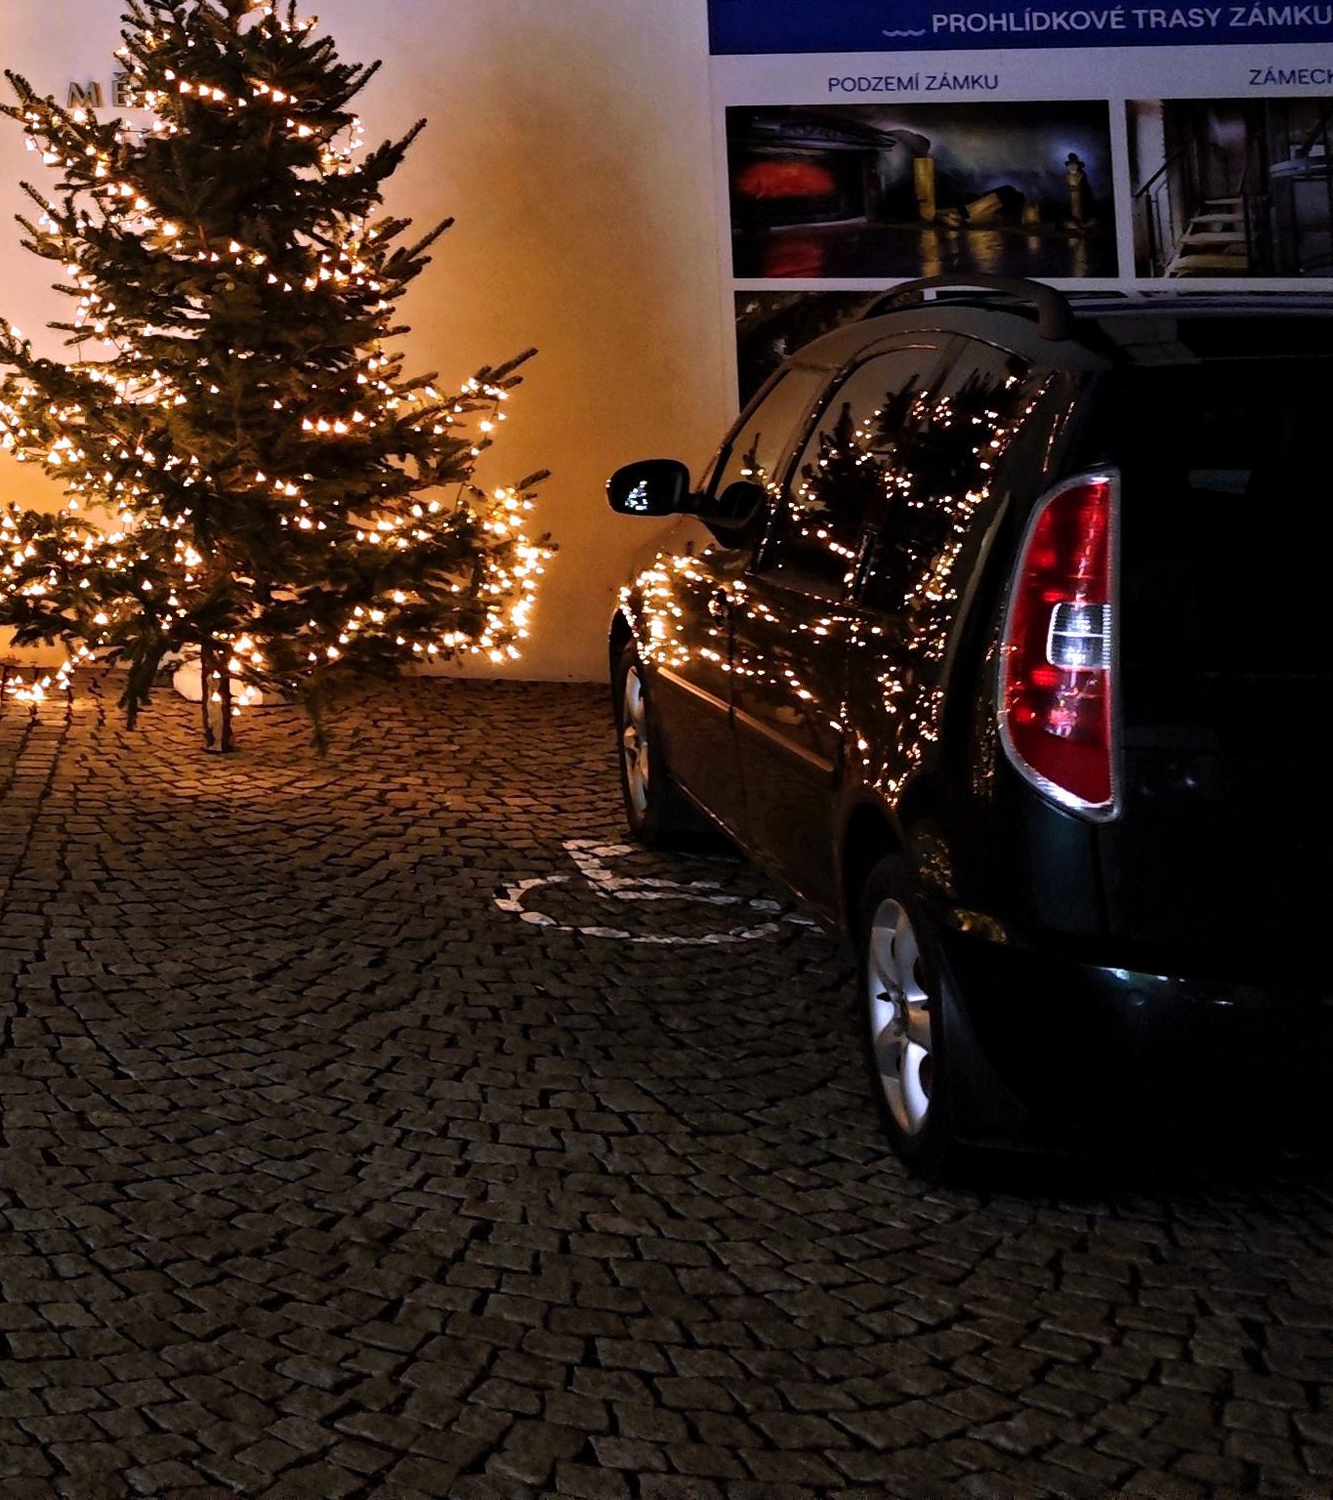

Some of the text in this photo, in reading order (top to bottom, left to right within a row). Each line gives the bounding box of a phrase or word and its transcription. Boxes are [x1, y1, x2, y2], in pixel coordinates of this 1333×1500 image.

[932, 1, 1333, 33] PROHLÍDKOVÉ TRASY ZÁMKU
[828, 71, 999, 93] PODZEMÍ ZÁMKU
